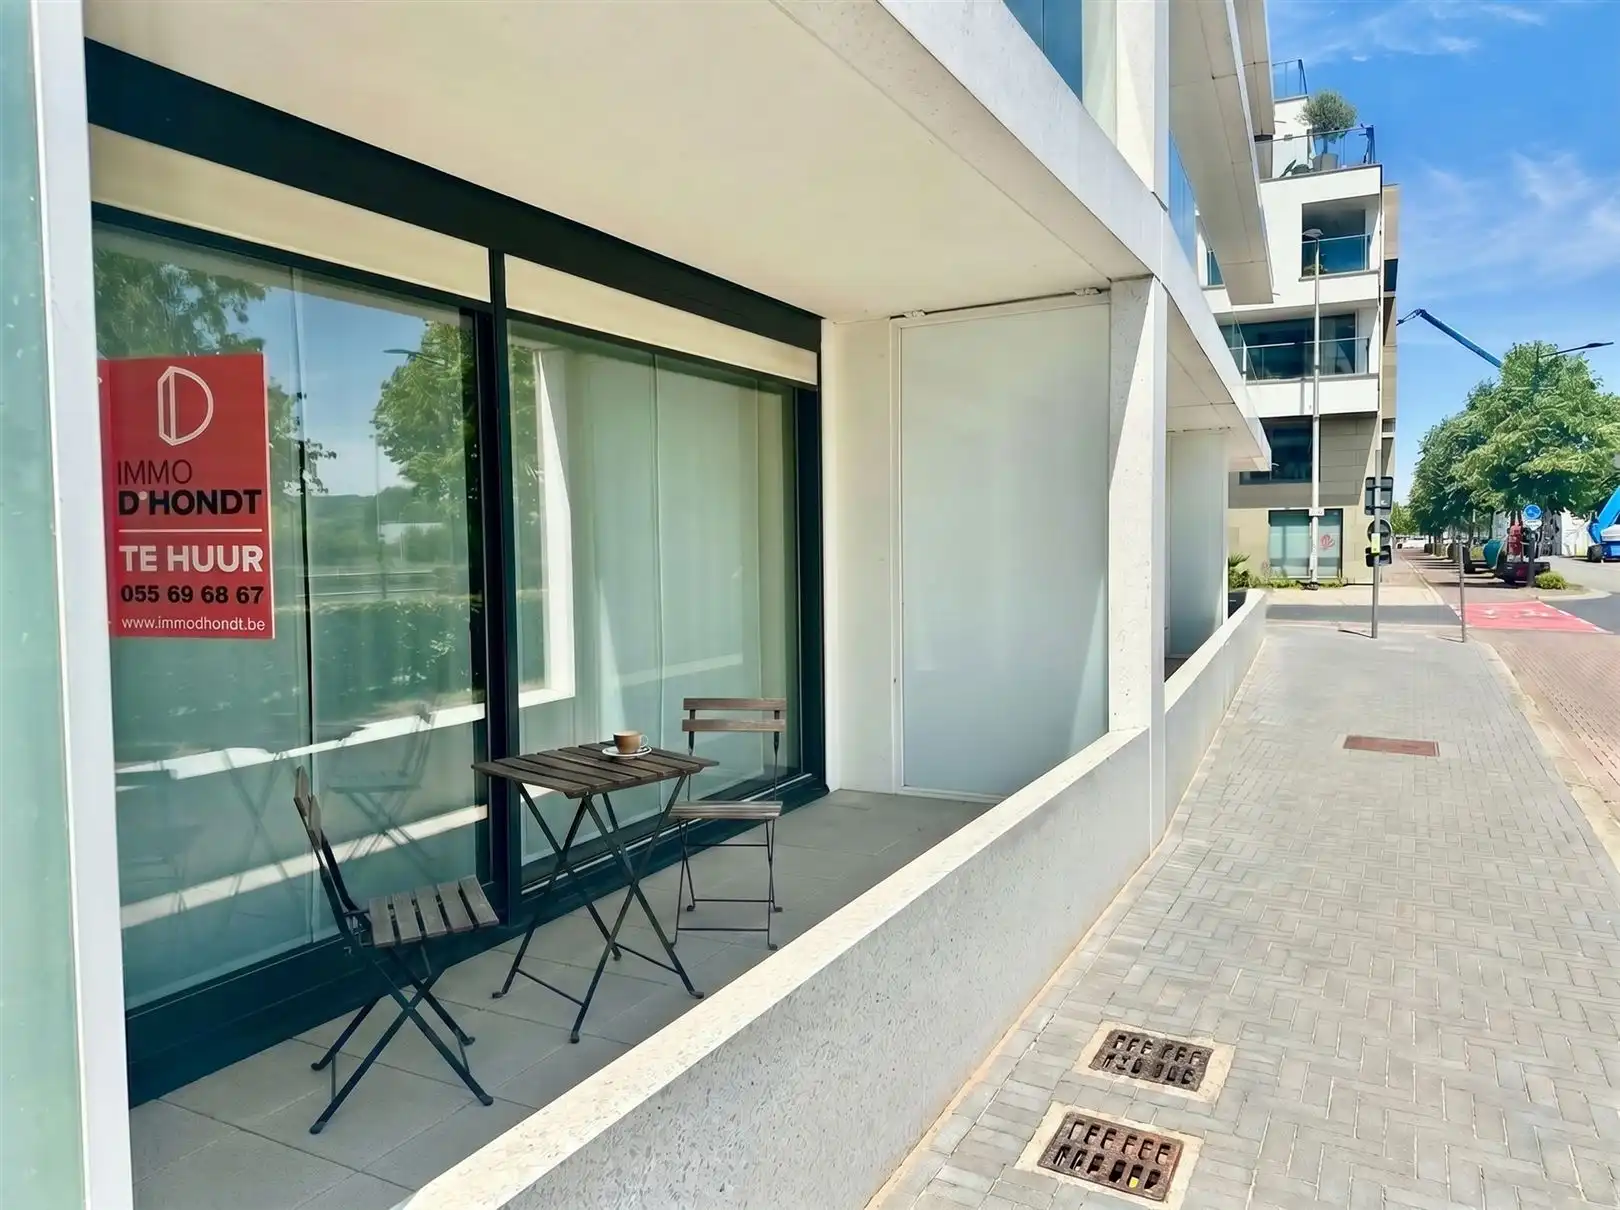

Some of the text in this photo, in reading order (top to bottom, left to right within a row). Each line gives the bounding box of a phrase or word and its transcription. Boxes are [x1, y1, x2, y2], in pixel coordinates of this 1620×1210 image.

[117, 459, 193, 485] IMMO
[118, 545, 264, 573] TE HUUR
[121, 585, 264, 604] 055 69 68 67
[121, 616, 266, 631] www.immodhondt.be
